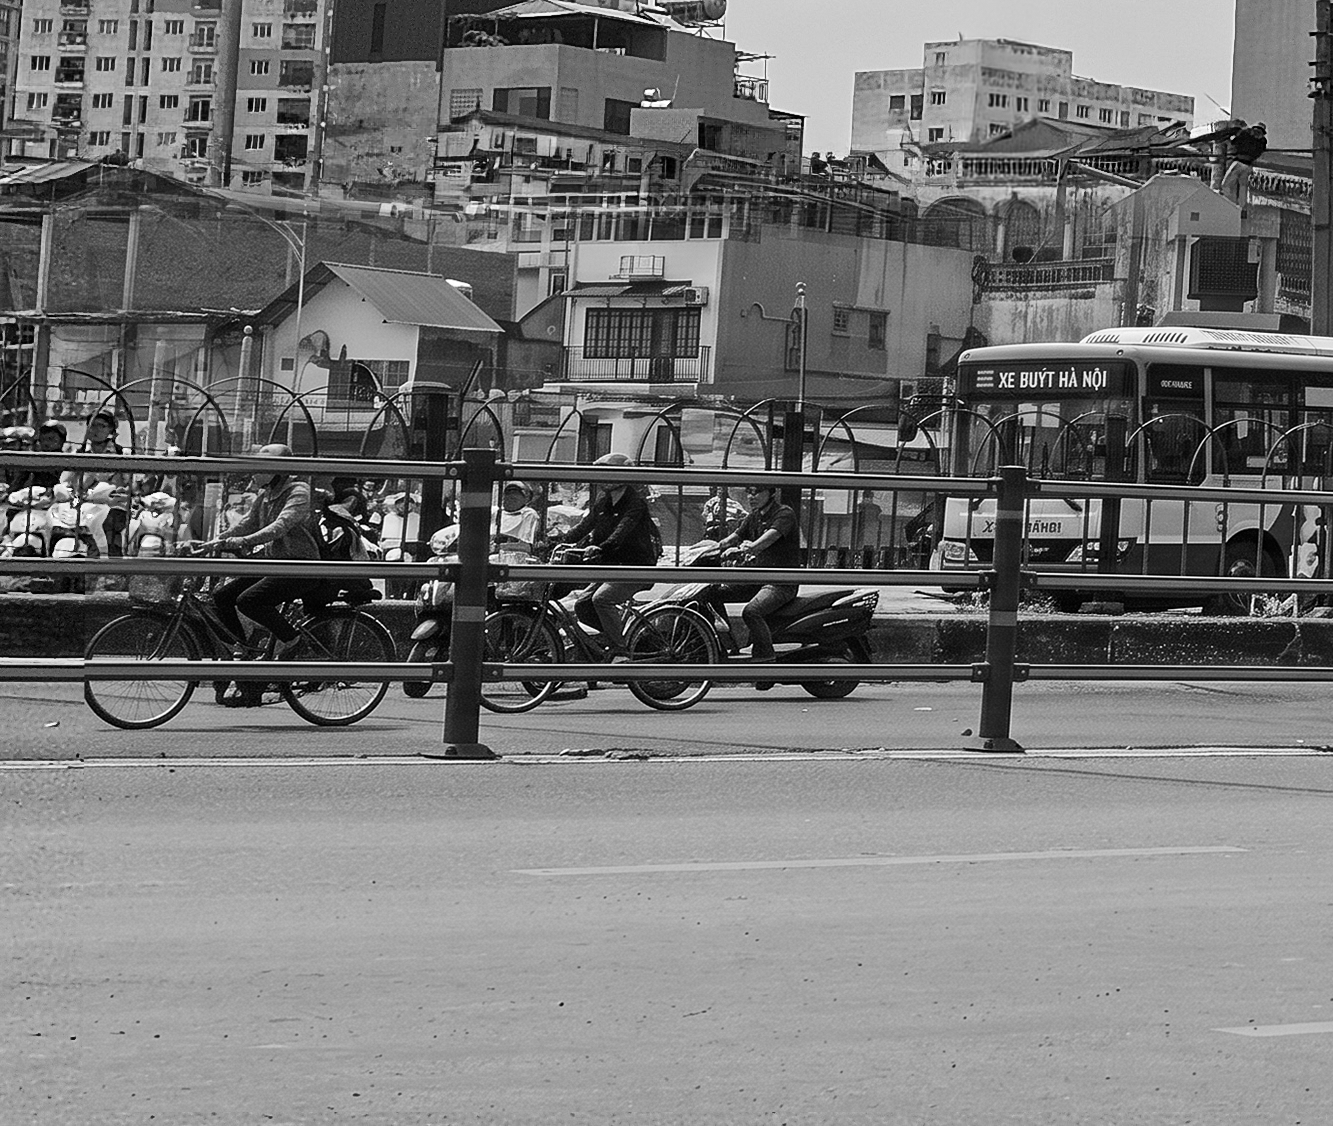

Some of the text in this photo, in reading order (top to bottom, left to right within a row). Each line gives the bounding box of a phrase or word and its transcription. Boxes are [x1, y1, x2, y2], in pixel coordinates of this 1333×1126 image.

[998, 372, 1015, 389] XE
[1019, 367, 1056, 389] BUÝT
[1059, 367, 1078, 388] HÀ
[1082, 367, 1107, 391] NỘI
